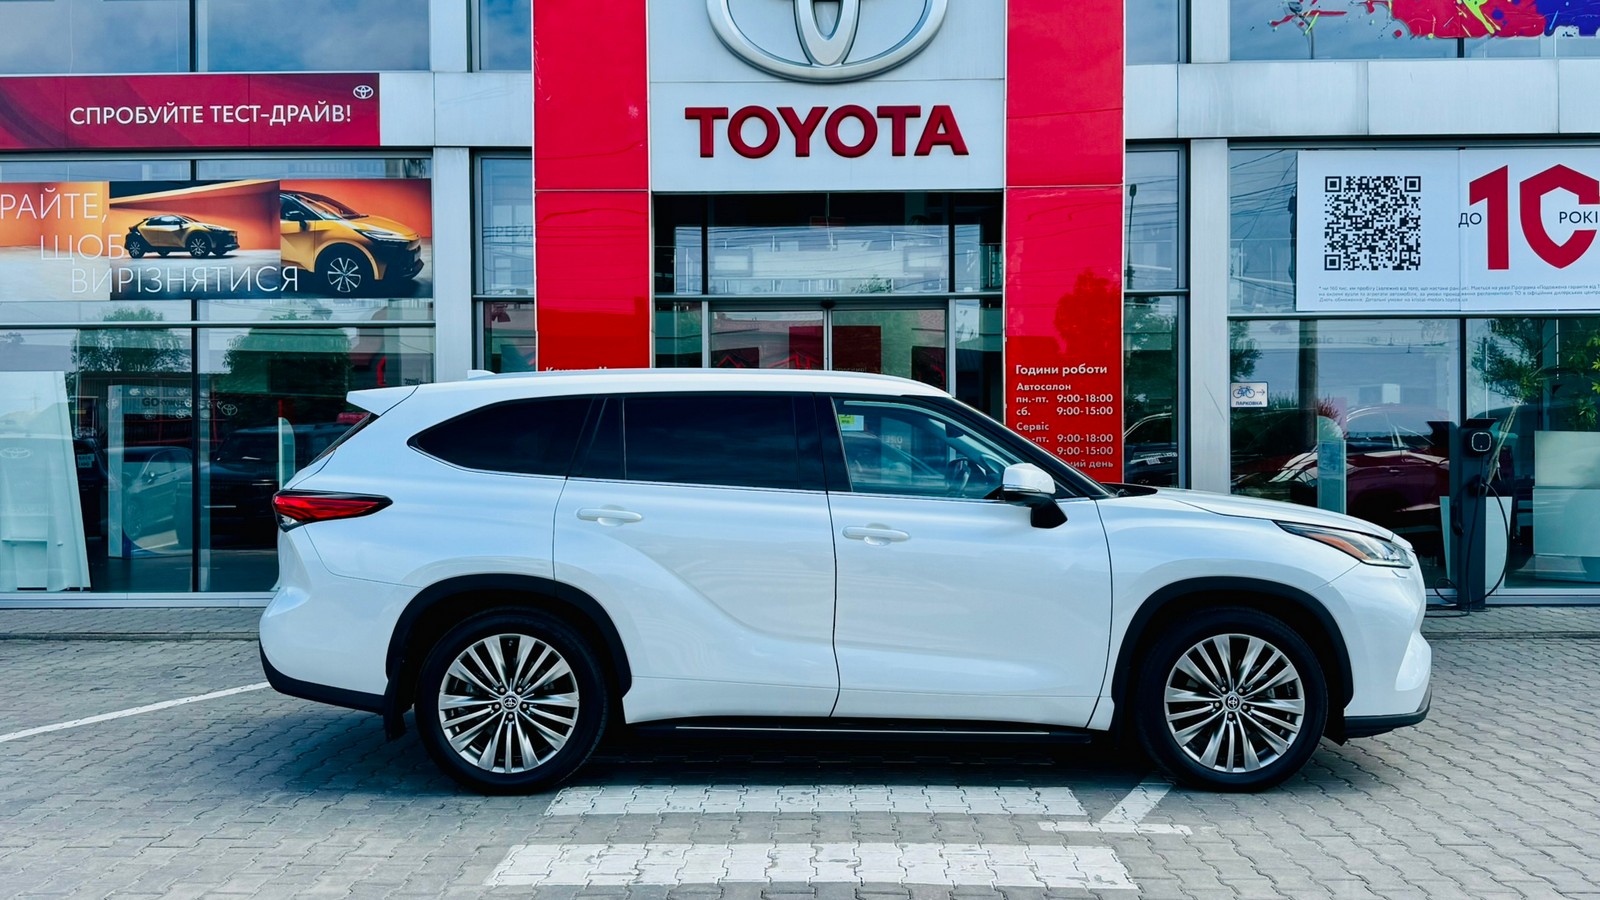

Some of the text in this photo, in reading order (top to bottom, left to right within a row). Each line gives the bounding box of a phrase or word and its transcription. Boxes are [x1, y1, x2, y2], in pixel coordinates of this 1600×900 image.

[69, 100, 352, 126] СПРОБУЙТЕ ТЕСТ-ДРАЙВ!
[684, 104, 969, 159] TOYOTA
[0, 187, 108, 224] РАЙТЕ,
[1458, 212, 1482, 228] ДО
[1469, 164, 1600, 270] 10
[40, 233, 125, 265] ЩОБ
[71, 265, 299, 294] ВИРІЗНЯТИСЯ
[1015, 362, 1108, 377] Години роботи
[1016, 382, 1072, 391] Автосалон
[1016, 393, 1113, 404] пн.-пт. 9:00-18:00
[1016, 406, 1113, 416] сб. 9:00-15:00
[1016, 422, 1050, 433] Сервіс
[1056, 433, 1113, 443] 9:00-18:00
[1056, 446, 1113, 456] 9:00-15:00
[1088, 460, 1114, 468] день
